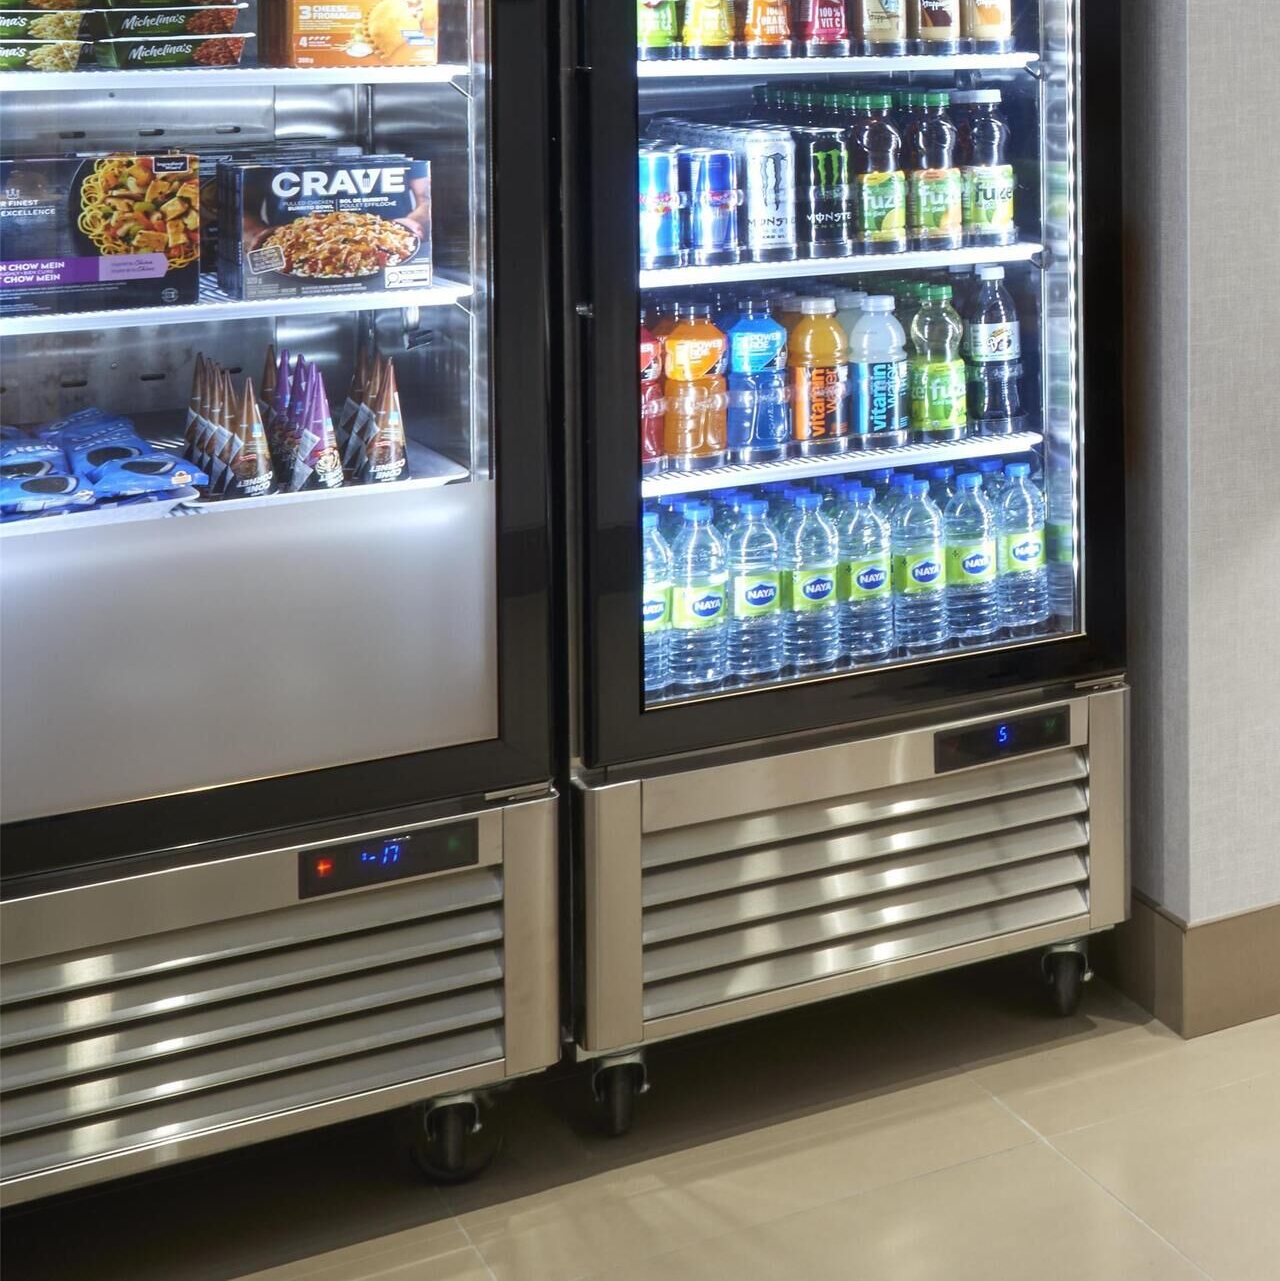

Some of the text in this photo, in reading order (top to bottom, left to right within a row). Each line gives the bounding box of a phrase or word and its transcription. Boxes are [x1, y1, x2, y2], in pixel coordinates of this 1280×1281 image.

[299, 5, 312, 20] 3
[120, 12, 187, 31] Michelina's
[128, 42, 193, 61] Michelina's
[272, 167, 411, 198] CRAVE
[1, 208, 56, 217] EXCELLENCE
[10, 261, 65, 271] CHOW MEIN
[3, 273, 61, 283] CHOW MEIN
[812, 368, 825, 437] vitamin
[871, 363, 887, 432] vitamin
[965, 556, 991, 569] NAYA
[859, 572, 886, 585] NAYA
[915, 566, 940, 578] NAYA
[747, 587, 775, 600] NAYA
[805, 582, 832, 595] NAYA
[694, 598, 721, 611] NAYA
